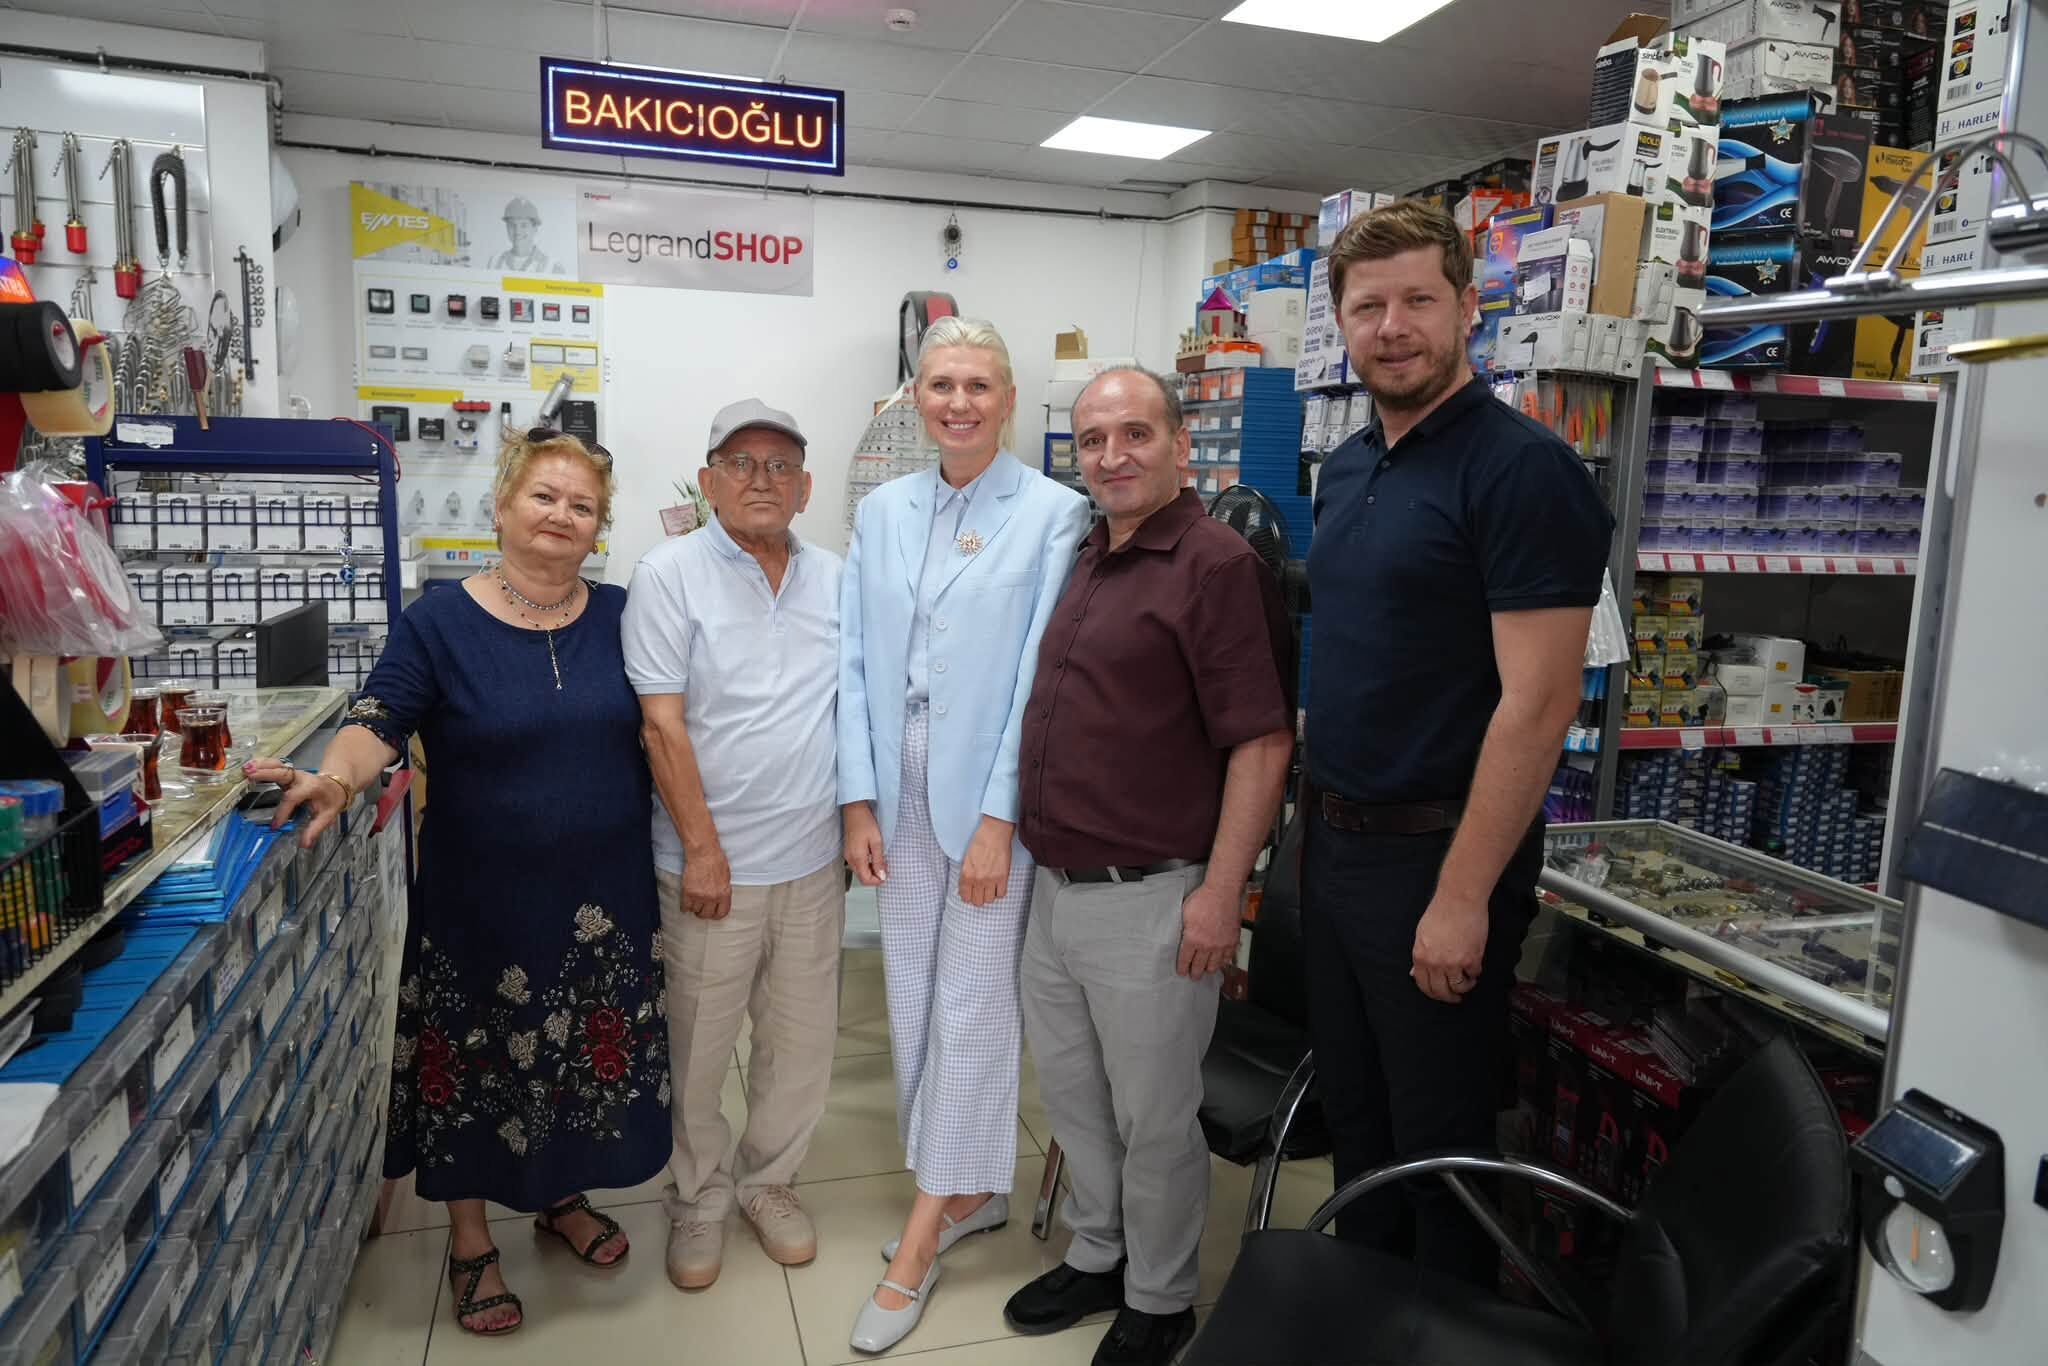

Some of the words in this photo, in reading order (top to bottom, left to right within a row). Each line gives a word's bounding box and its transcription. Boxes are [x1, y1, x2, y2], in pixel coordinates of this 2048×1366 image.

[565, 89, 824, 149] BAKICIOĞLU
[1957, 110, 2001, 131] HARLEM
[588, 221, 804, 265] LegrandSHOP
